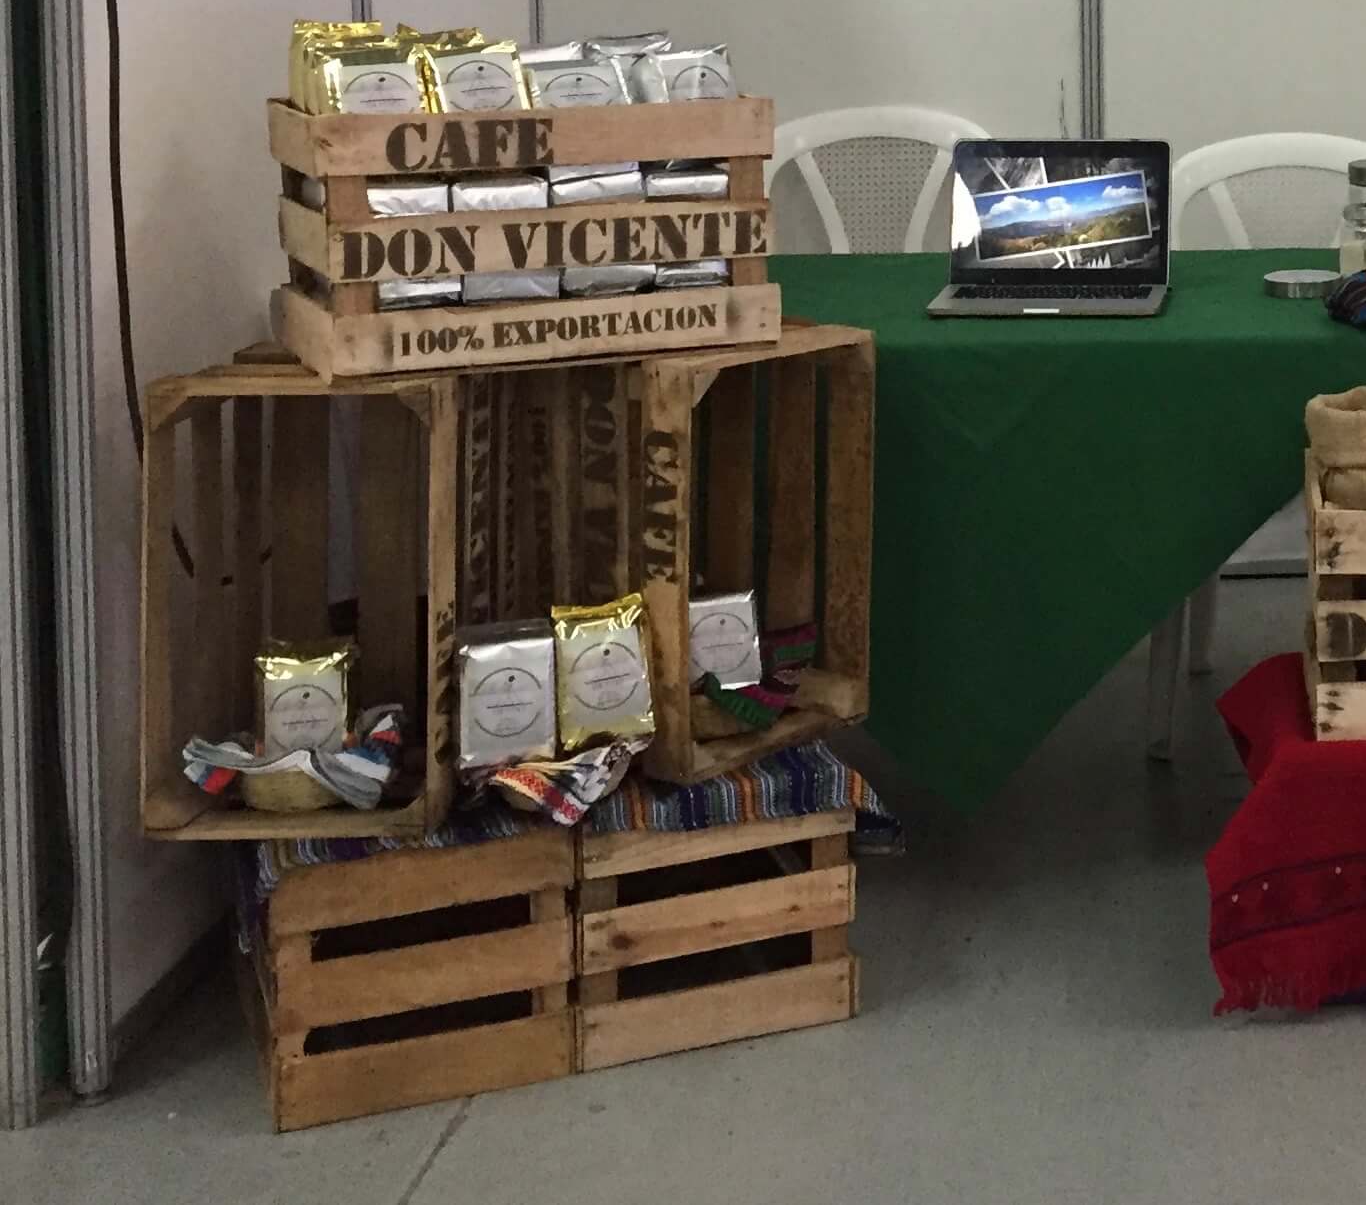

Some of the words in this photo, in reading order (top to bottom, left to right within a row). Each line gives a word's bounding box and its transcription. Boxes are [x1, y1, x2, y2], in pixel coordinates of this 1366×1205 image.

[386, 118, 554, 172] CAFE
[340, 225, 480, 279] DON
[501, 209, 768, 269] VICENTE
[400, 326, 485, 357] 100%
[494, 304, 718, 346] EXPORTACION
[643, 430, 679, 584] CAFE
